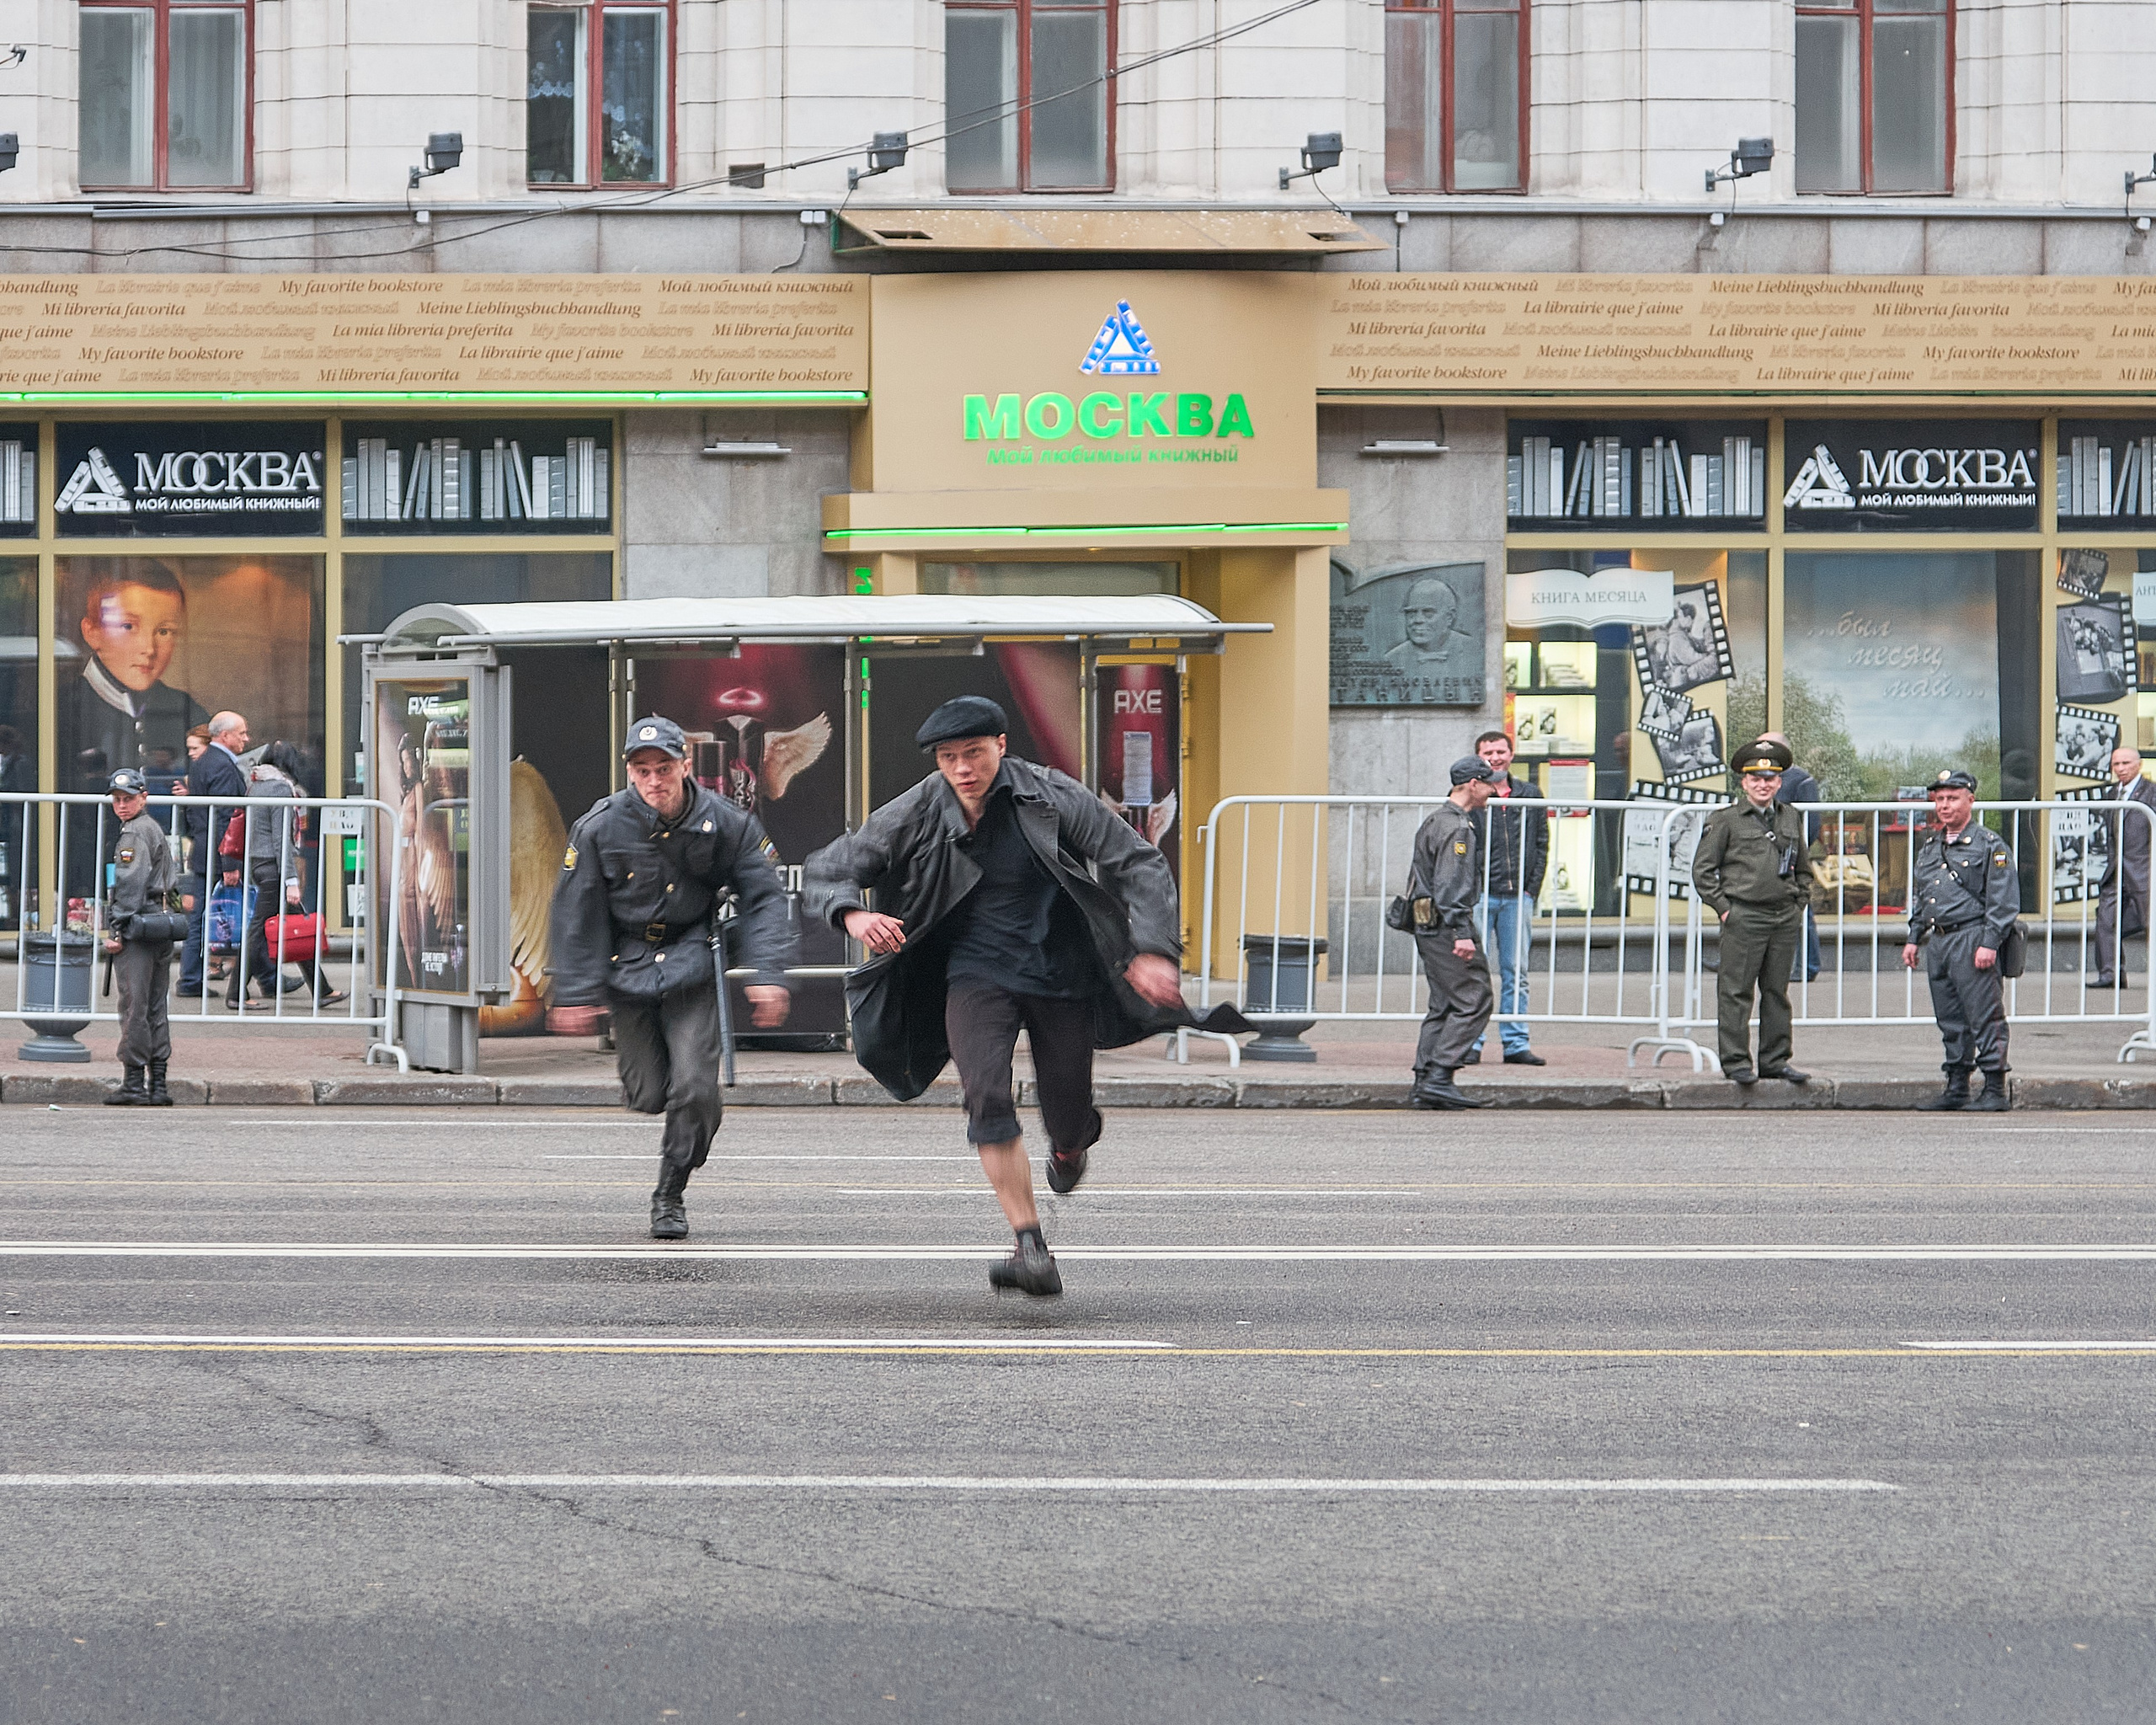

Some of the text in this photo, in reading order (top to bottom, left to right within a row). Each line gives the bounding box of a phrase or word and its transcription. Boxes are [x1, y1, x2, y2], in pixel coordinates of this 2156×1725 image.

[280, 279, 443, 296] My favorite bookstore
[659, 280, 853, 292] Мой любимый книжный
[1348, 278, 1539, 291] Мой любимый книжный
[1710, 280, 1753, 292] Meine
[2113, 281, 2135, 297] My
[42, 303, 61, 315] Mi
[121, 302, 185, 318] favorita
[417, 302, 462, 314] Meine
[1524, 301, 1683, 318] La librairie que j'aime
[1873, 303, 1892, 315] Mi
[1947, 303, 2009, 319] favorita
[23, 325, 73, 341] j'aime
[333, 323, 514, 339] La mia libreria preferita
[712, 323, 732, 336] Mi
[789, 323, 854, 339] favorita
[1348, 322, 1365, 334] Mi
[1423, 322, 1486, 339] favorita
[1709, 323, 1865, 340] La librairie que j'aime
[2112, 325, 2129, 337] La
[78, 346, 243, 363] My favorite bookstore
[459, 345, 623, 362] La librairie que j'aime
[1537, 344, 1582, 357] Meine
[1923, 345, 2079, 362] My favorite bookstore
[23, 371, 51, 385] que
[51, 369, 102, 385] j'aime
[318, 369, 336, 381] Mi
[396, 368, 460, 384] favorita
[690, 368, 852, 385] My favorite bookstore
[1348, 366, 1507, 382] My favorite bookstore
[1757, 367, 1914, 384] La librairie que j'aime
[2118, 368, 2137, 380] Mi
[963, 392, 1255, 441] МОСКВА
[986, 444, 1239, 465] Мой любимый книжный
[135, 496, 320, 511] МОЙ ЛЮБИМЫЙ КНИЖНЫЙ!
[1860, 492, 1892, 506] МОЙ
[1893, 492, 1963, 506] ЛЮБИМЫЙ
[1531, 590, 1648, 605] КНИГА МЕСЯЦА
[1849, 643, 1944, 674] месяц
[1113, 689, 1163, 713] AXE
